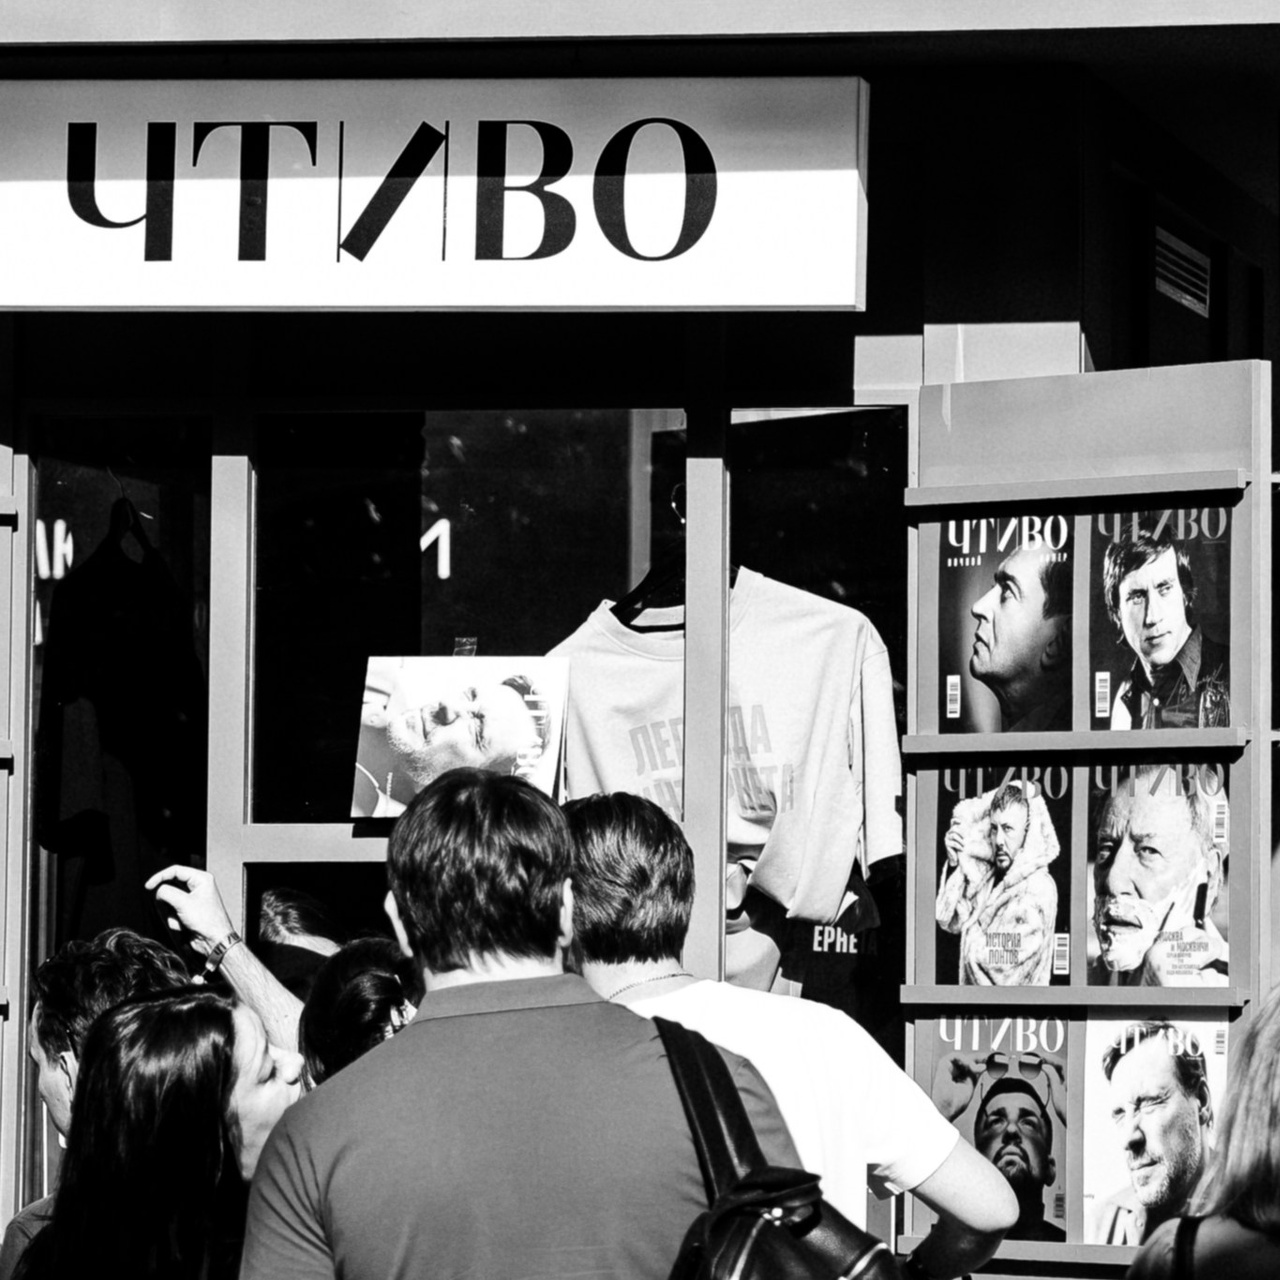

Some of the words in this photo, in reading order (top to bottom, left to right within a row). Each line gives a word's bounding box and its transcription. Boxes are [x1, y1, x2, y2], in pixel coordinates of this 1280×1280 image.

[66, 117, 719, 263] ЧТИВО
[948, 515, 1068, 554] ЧТИВО
[939, 1017, 1065, 1052] ЧТИВО
